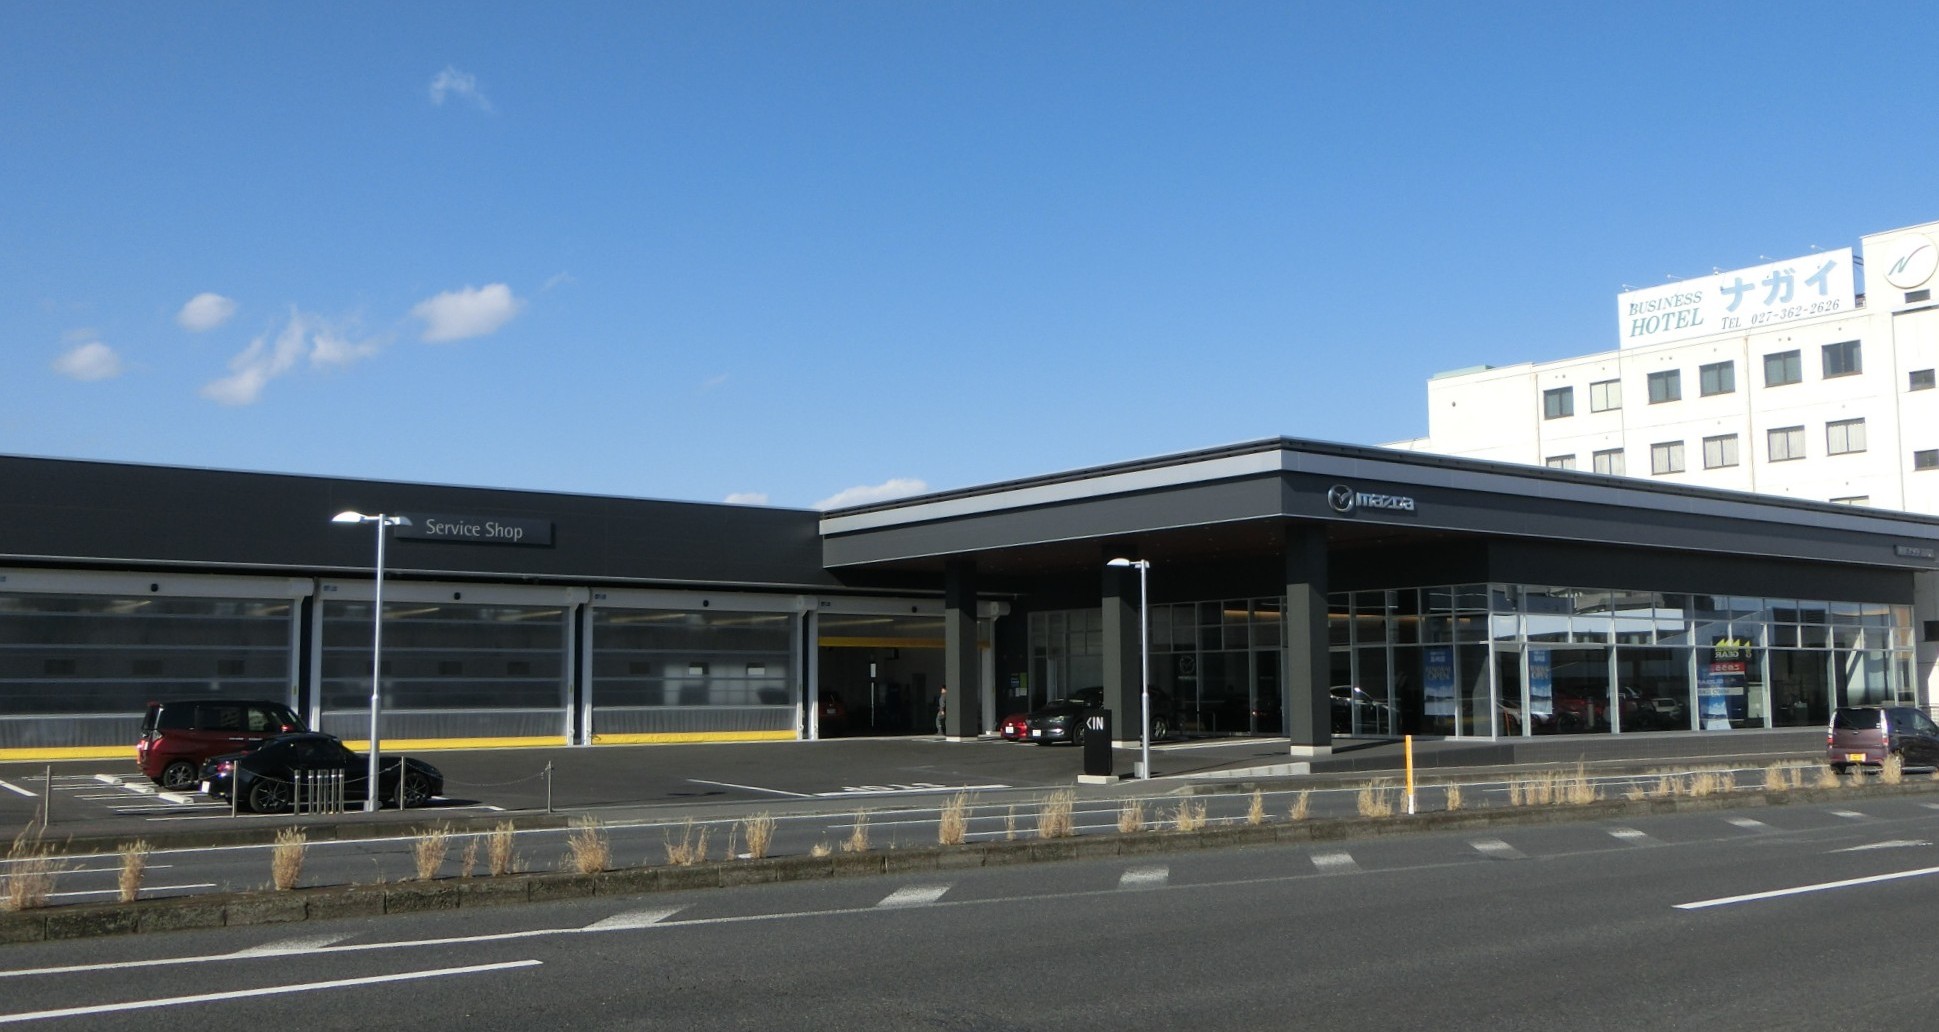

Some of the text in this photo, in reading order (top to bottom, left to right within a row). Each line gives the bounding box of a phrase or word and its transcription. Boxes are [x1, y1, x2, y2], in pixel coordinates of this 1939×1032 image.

[1720, 259, 1838, 313] ナガイ
[1629, 290, 1703, 316] BUSINESS
[1721, 298, 1840, 330] TEL 027-362-2626
[1630, 307, 1704, 337] HOTEL
[426, 519, 523, 542] Service Shop
[1092, 716, 1104, 731] IN
